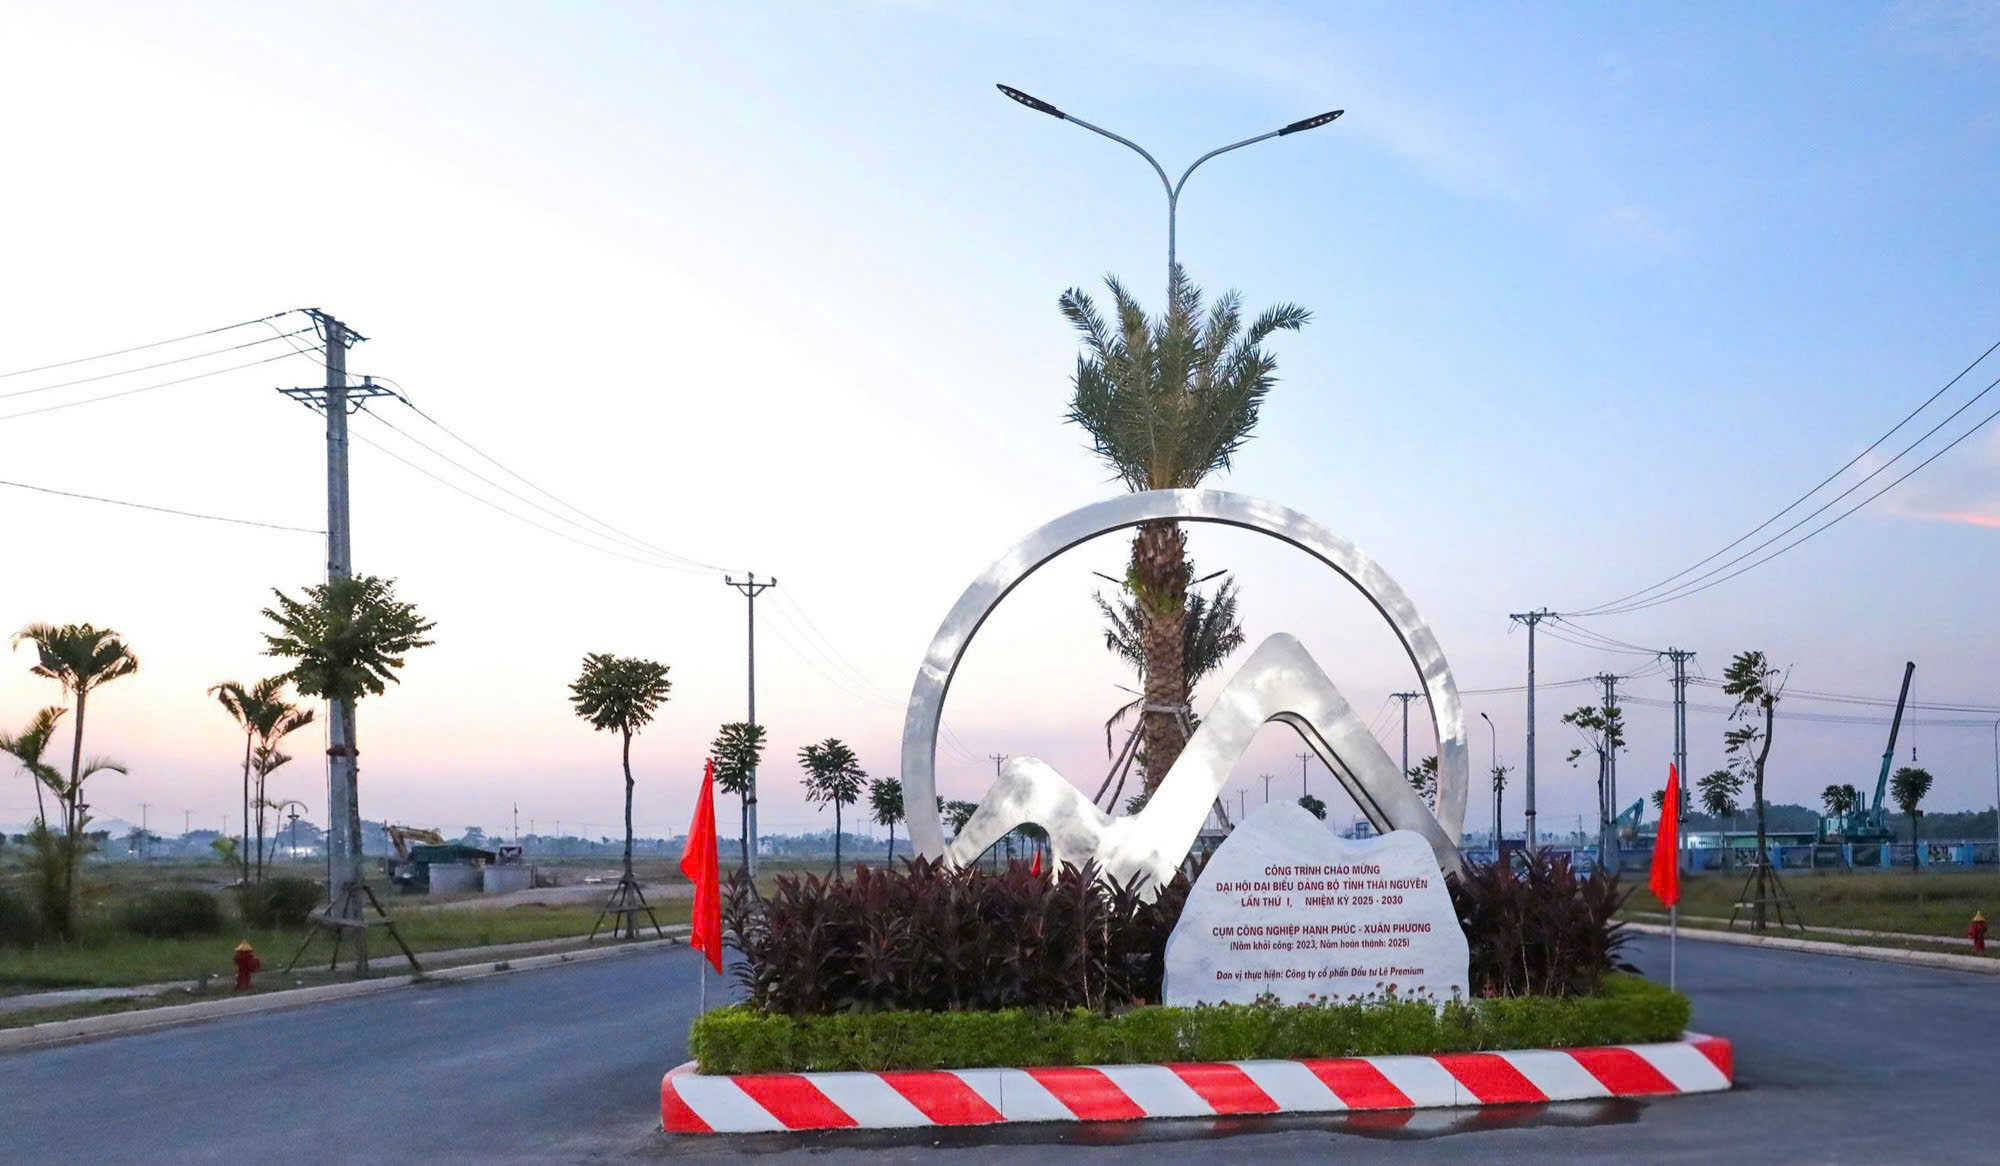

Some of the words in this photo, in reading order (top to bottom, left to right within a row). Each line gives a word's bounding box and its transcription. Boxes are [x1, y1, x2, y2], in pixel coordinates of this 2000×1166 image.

[1265, 864, 1291, 876] CÔNG
[1236, 880, 1251, 894] HỘI
[1366, 879, 1387, 890] THÁI
[1390, 878, 1428, 889] NGUYÊN
[1262, 895, 1281, 906] THỨ
[1306, 896, 1334, 908] NHIỆM
[1352, 896, 1374, 905] 2025
[1381, 896, 1403, 904] 2030
[1212, 927, 1234, 938] CỤM
[1236, 924, 1263, 936] CÔNG
[1266, 924, 1300, 937] NGHIỆP
[1302, 925, 1328, 938] HẠNH
[1331, 922, 1356, 934] PHÚC
[1392, 922, 1431, 933] PHƯƠNG
[1272, 940, 1294, 952] công:
[1388, 938, 1410, 948] 2025)
[1286, 969, 1306, 980] Công
[1308, 970, 1316, 980] ty
[1390, 966, 1424, 976] Premium
